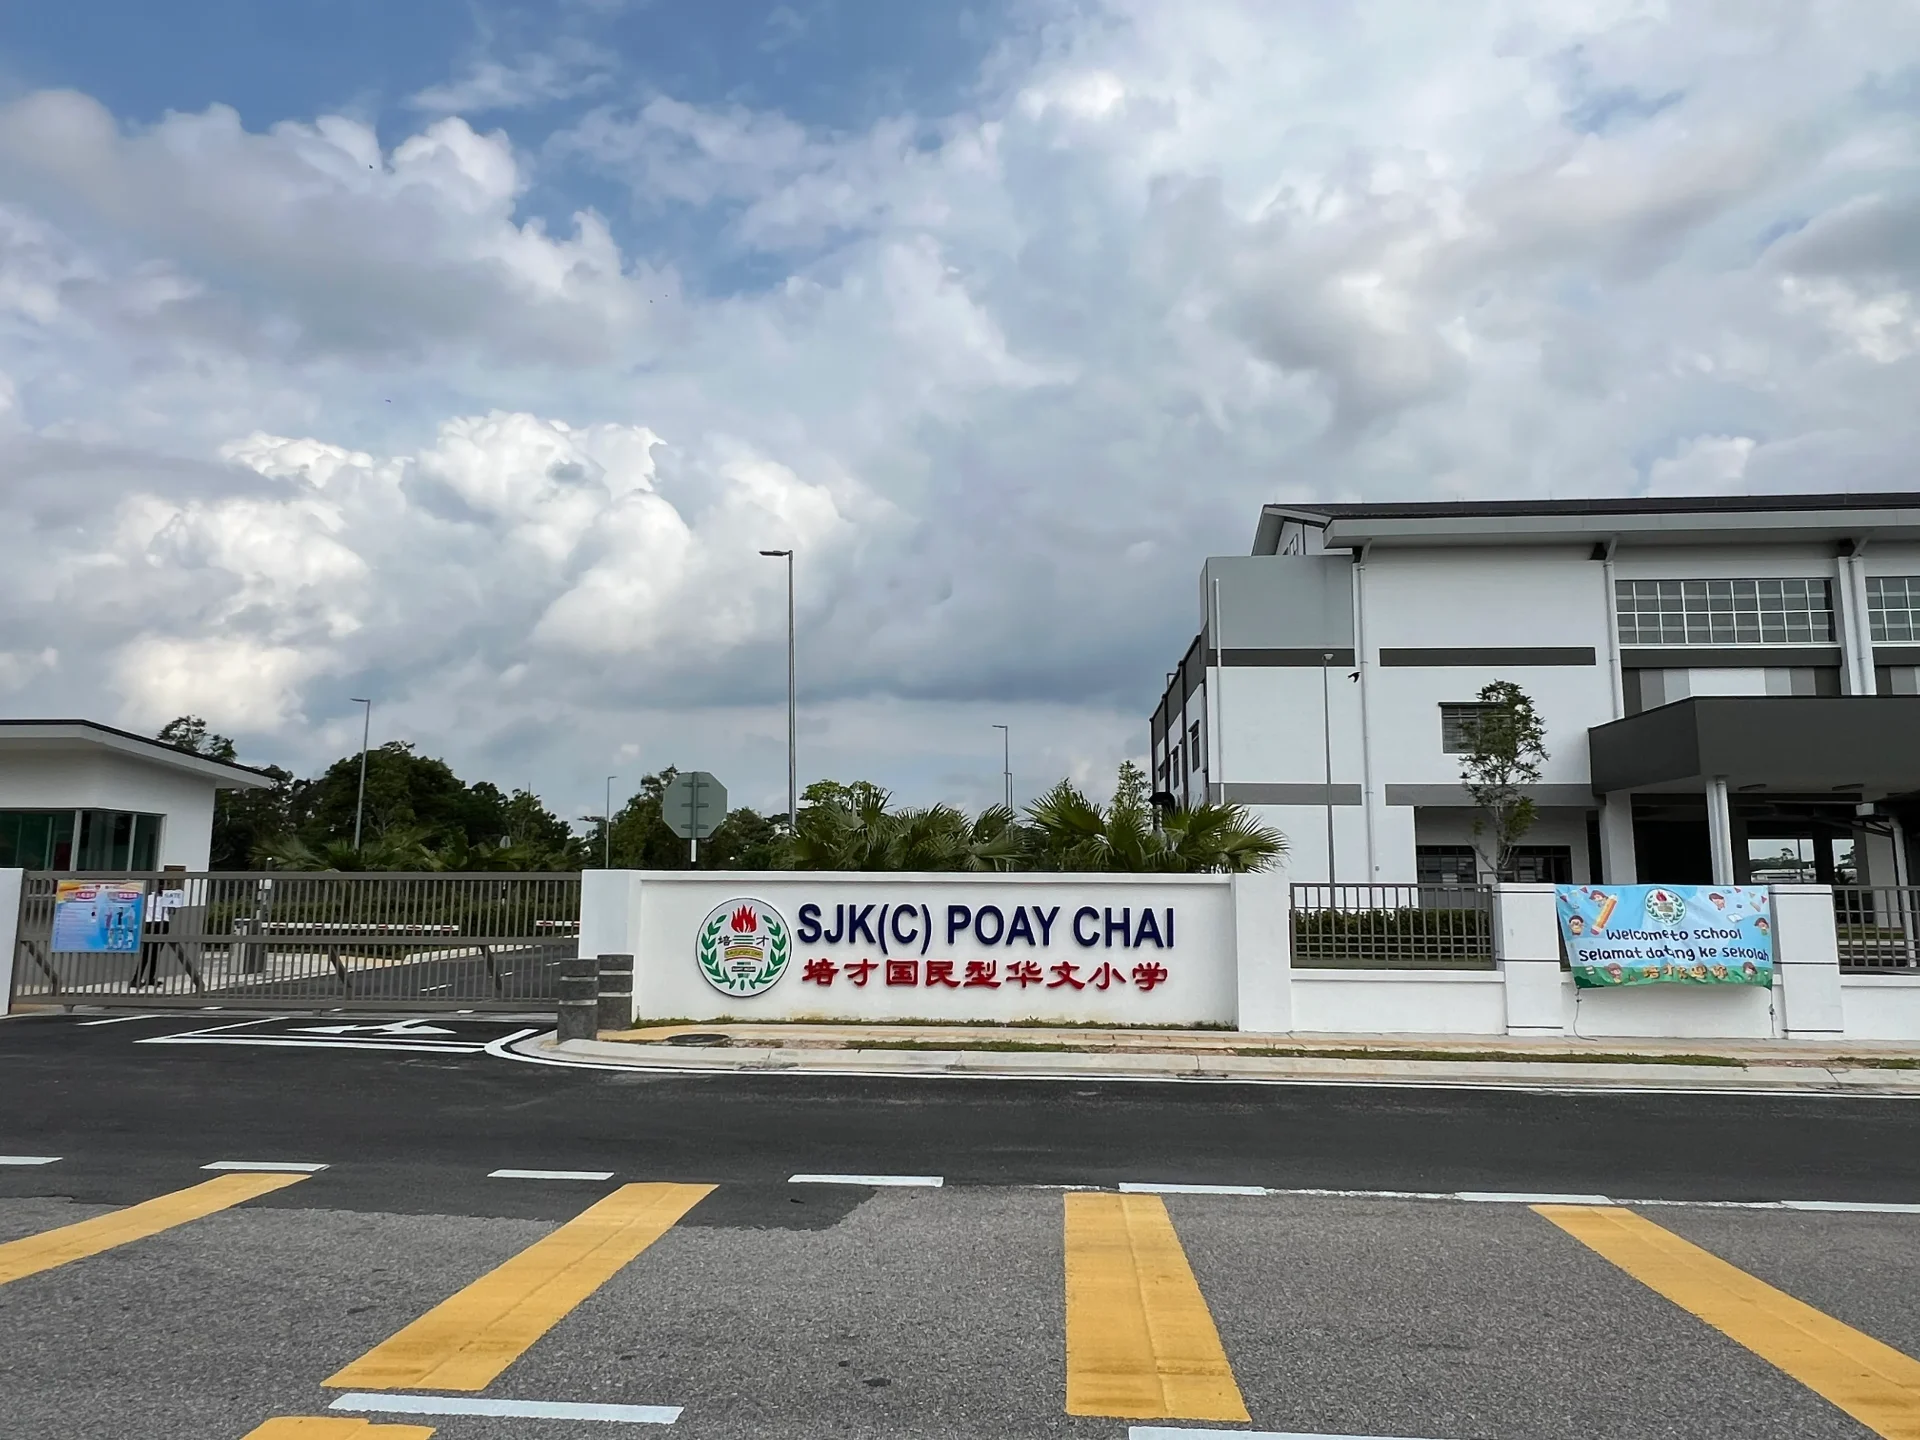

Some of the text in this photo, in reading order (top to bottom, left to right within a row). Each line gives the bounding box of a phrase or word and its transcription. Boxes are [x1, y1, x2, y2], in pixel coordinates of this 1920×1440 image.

[797, 903, 1174, 955] SJK(C) POAY CHAI
[1606, 927, 1743, 941] Welcome to school
[1698, 945, 1717, 958] ke
[1722, 947, 1769, 961] sekolah
[802, 958, 1168, 991] 培才国民型华文小学
